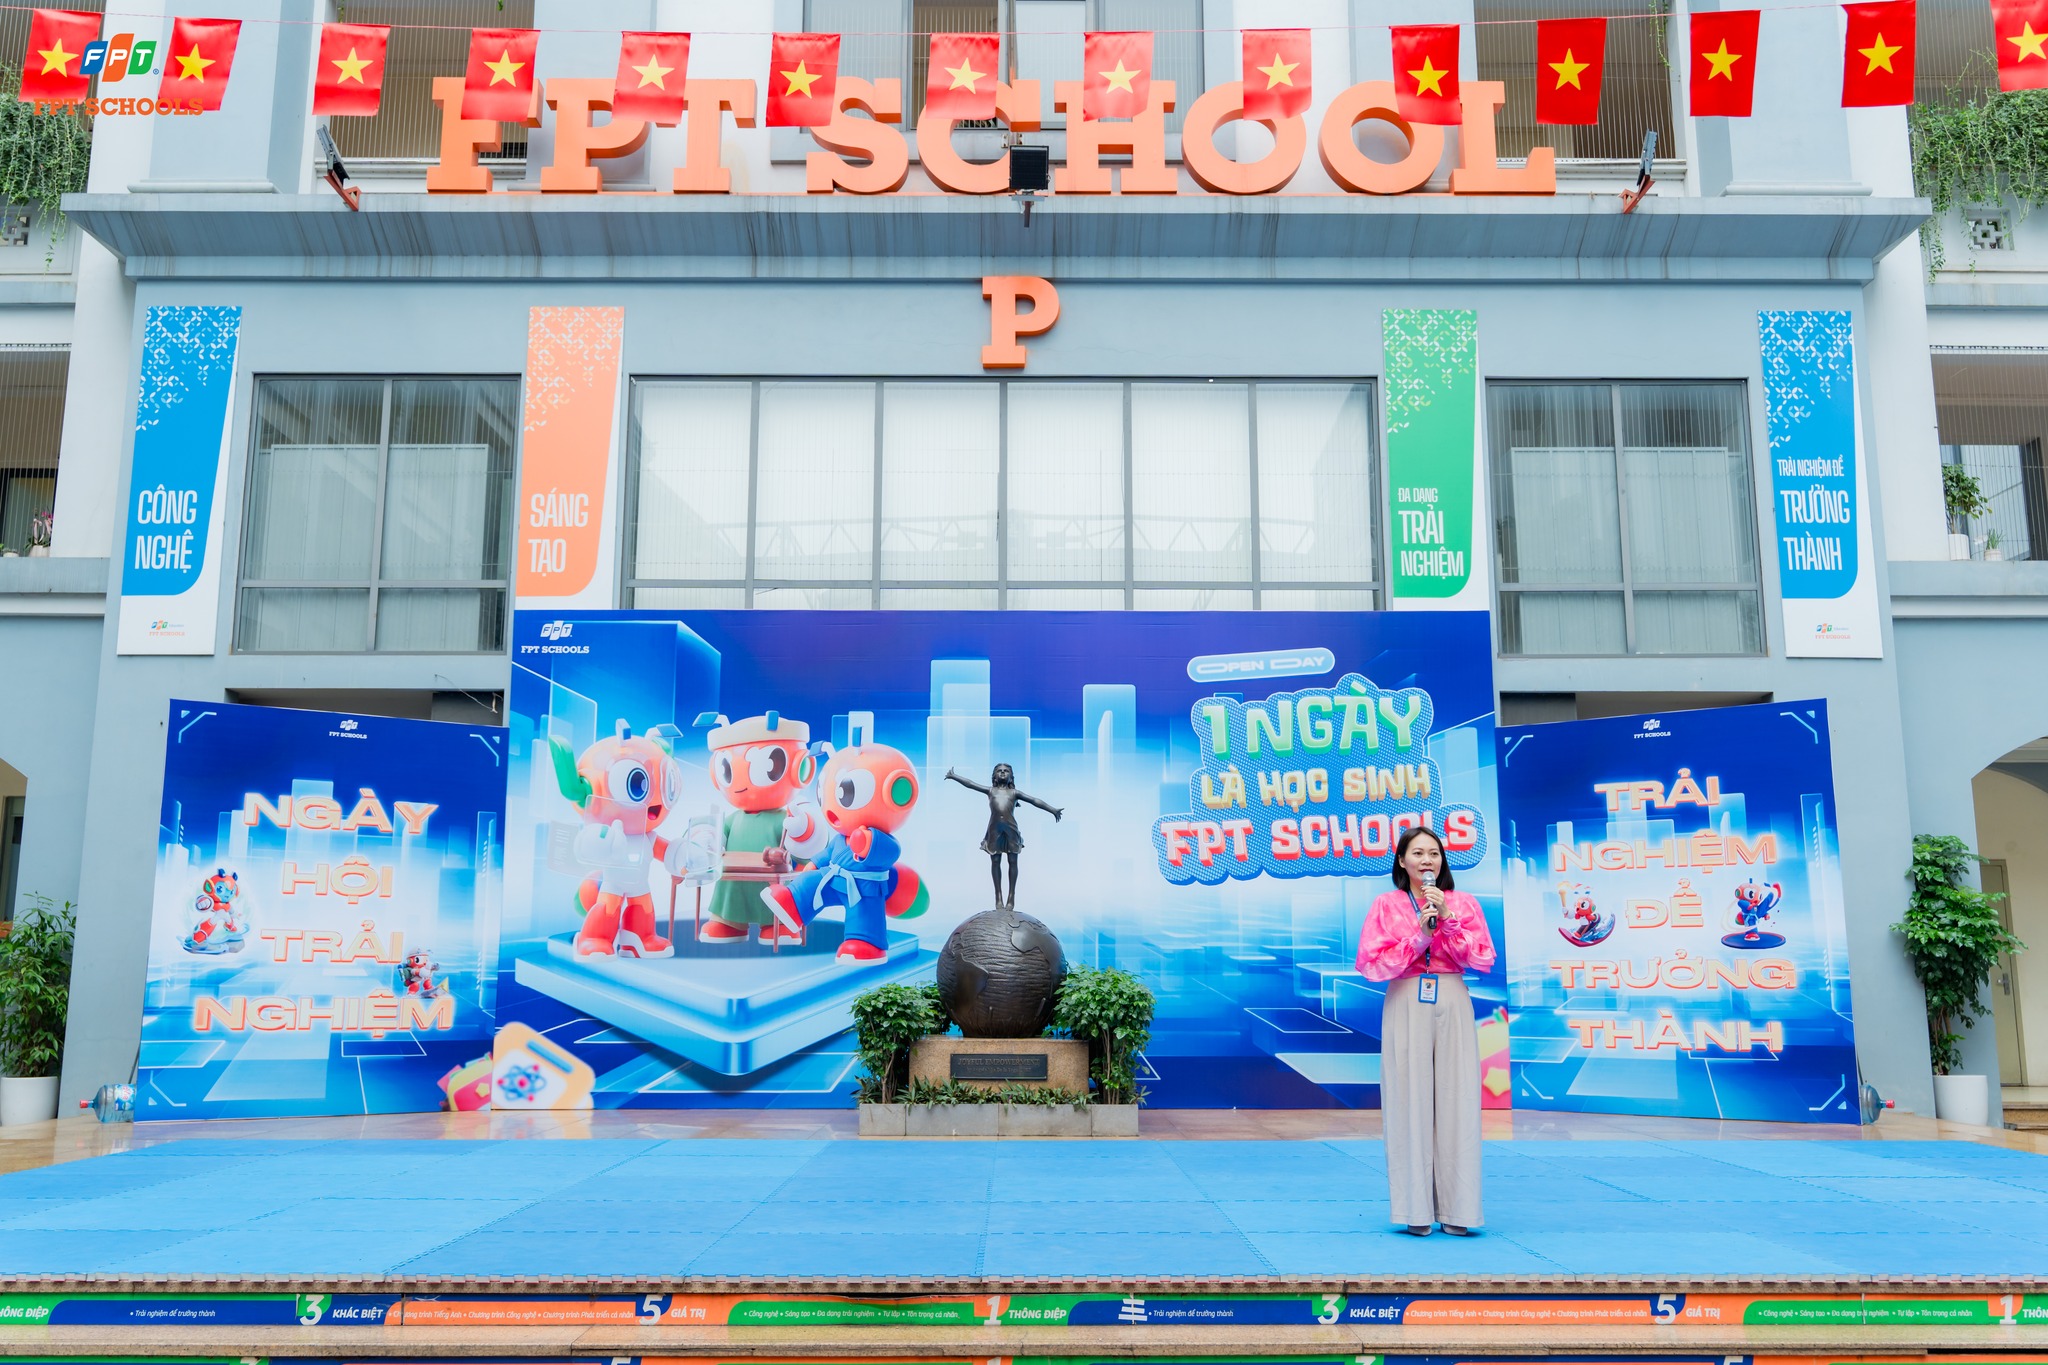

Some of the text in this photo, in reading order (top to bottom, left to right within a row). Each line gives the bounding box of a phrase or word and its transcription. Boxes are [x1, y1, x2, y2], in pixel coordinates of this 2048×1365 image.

[427, 77, 1556, 194] FPT SCHOOL
[982, 276, 1060, 369] P
[1777, 454, 1845, 478] TRẢI NGHIỆM ĐỂ
[137, 484, 198, 525] CÔNG
[529, 487, 589, 528] SÁNG
[1398, 488, 1438, 505] ĐA DẠNG
[1780, 484, 1851, 524] TRƯỞNG
[1398, 504, 1445, 545] TRẢI
[134, 529, 194, 574] NGHỆ
[528, 538, 567, 577] TẠO
[1400, 546, 1464, 580] NGHIỆM
[1783, 530, 1843, 571] THÀNH
[521, 645, 590, 654] FPT SCHOOLS
[1196, 656, 1325, 674] OPEN DAY
[1203, 681, 1422, 760] 1 NGÀY
[1201, 764, 1431, 812] LÀ HỌC SINH
[1594, 767, 1720, 811] TRẢI
[243, 788, 439, 835] NGÀY
[1160, 819, 1253, 867] FPT
[1553, 828, 1777, 874] NGHIỆM
[281, 855, 394, 905] HỘI
[1626, 878, 1704, 929] ĐỂ
[260, 920, 404, 964] TRẢI
[1550, 949, 1797, 990] TRƯỞNG
[194, 988, 454, 1038] NGHIỆM
[1567, 1008, 1783, 1053] THÀNH
[0, 1306, 49, 1320] HÔNG ĐIỆP
[299, 1294, 384, 1326] 3 KHÁC BIỆT
[450, 1310, 462, 1318] Anh
[639, 1294, 707, 1326] 5 GIÁ TRỊ
[748, 1310, 763, 1319] Công
[784, 1310, 800, 1319] Sáng
[983, 1295, 1067, 1326] 1 THÔNG ĐIỆP
[1153, 1309, 1164, 1317] Trải
[1165, 1309, 1187, 1319] nghiệm
[1216, 1309, 1234, 1317] thành
[1317, 1293, 1401, 1325] 3 KHÁC BIỆT
[1465, 1309, 1477, 1318] Anh
[1654, 1293, 1721, 1325] 5 GIÁ TRỊ
[1763, 1309, 1778, 1319] Công
[1799, 1309, 1815, 1319] Sáng
[1999, 1294, 2048, 1325] 1 THÔN
